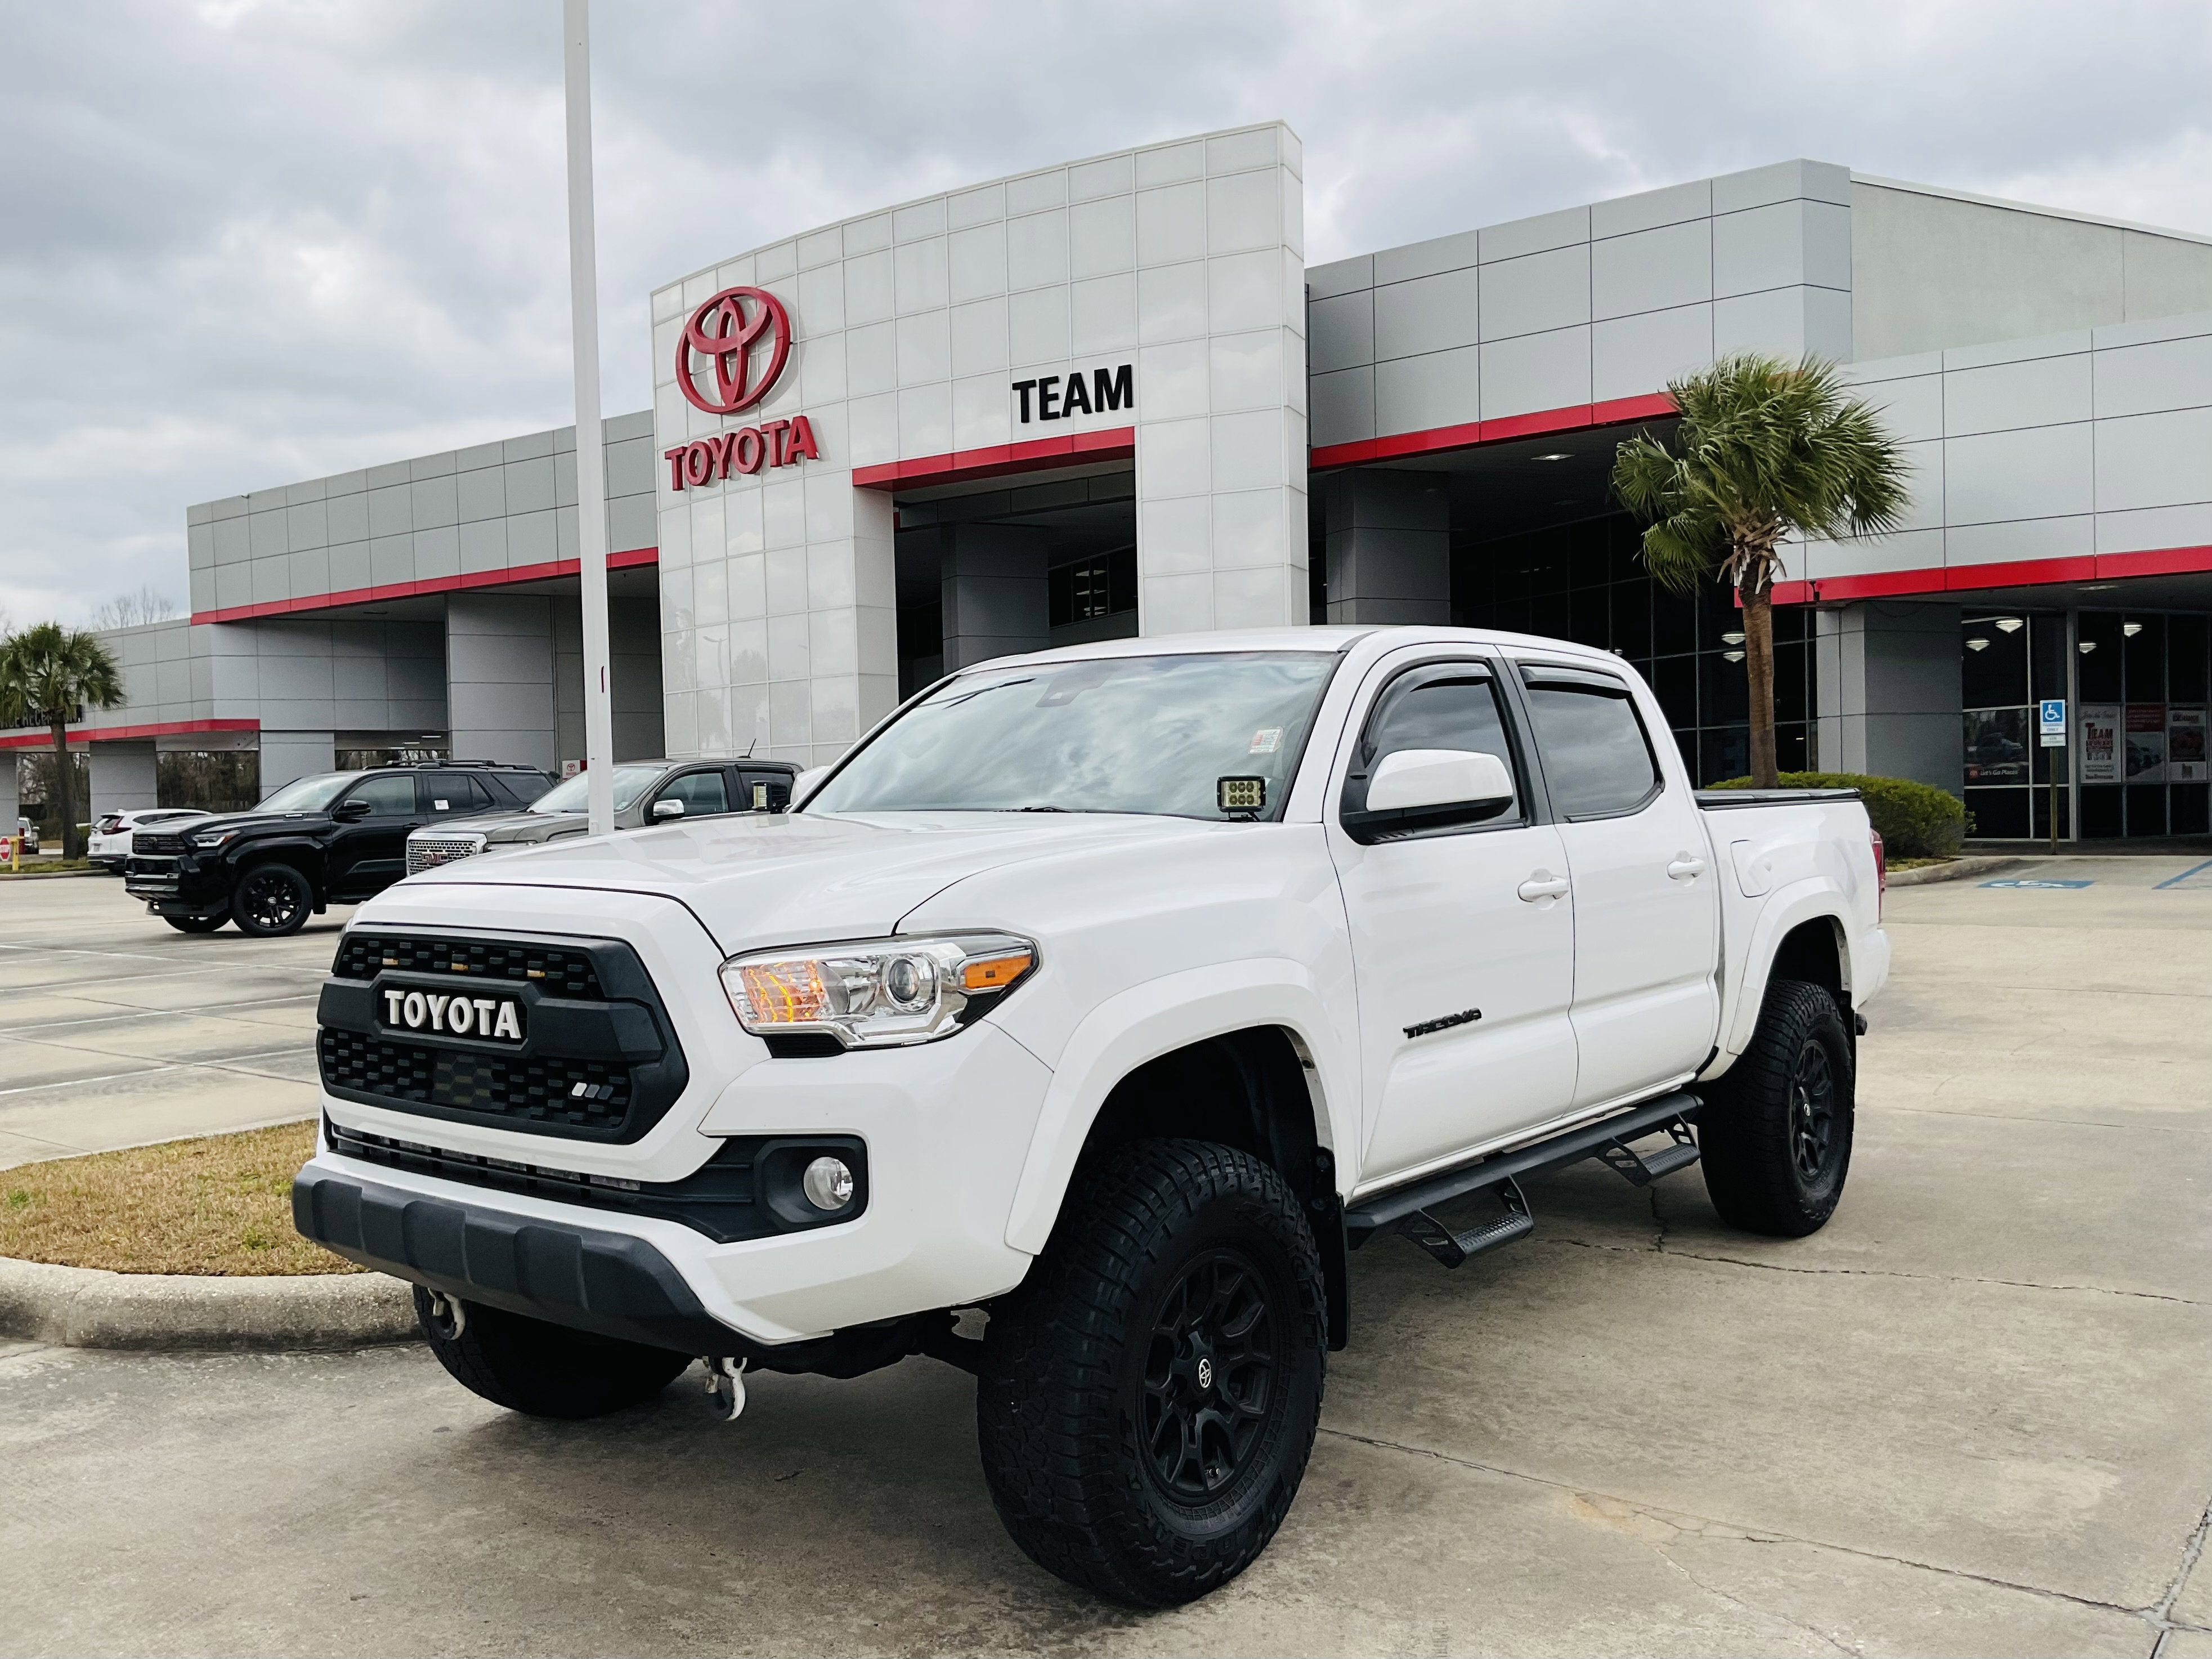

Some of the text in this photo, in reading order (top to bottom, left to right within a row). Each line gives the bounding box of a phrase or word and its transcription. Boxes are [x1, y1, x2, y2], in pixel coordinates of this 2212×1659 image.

[1012, 364, 1134, 423] TEAM
[665, 415, 818, 491] TOYOTA
[421, 852, 448, 864] GMC
[384, 990, 522, 1039] TOYOTA
